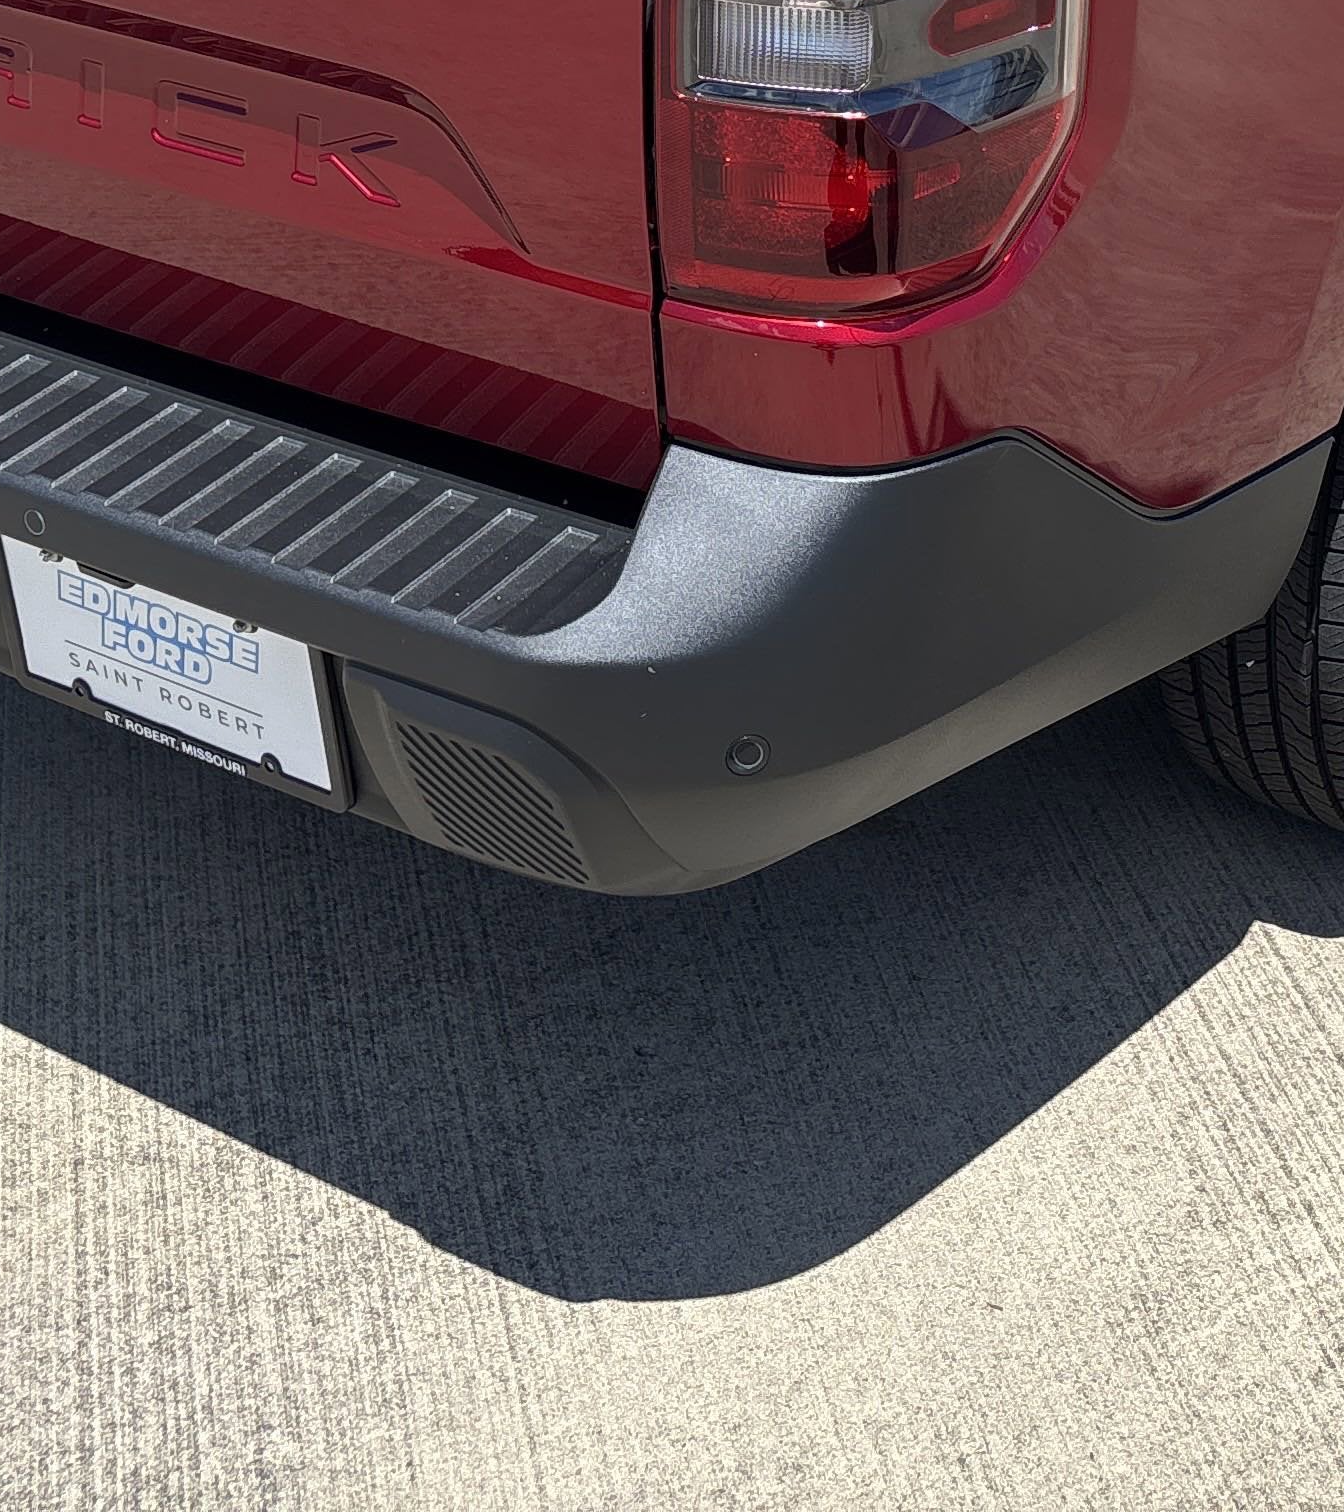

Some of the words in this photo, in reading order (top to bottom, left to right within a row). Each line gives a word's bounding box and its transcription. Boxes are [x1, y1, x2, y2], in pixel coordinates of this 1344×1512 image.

[57, 569, 111, 617] ED
[113, 589, 260, 675] MORSE
[101, 615, 213, 685] FORD
[67, 651, 145, 693] SAINT
[159, 686, 266, 740] ROBERT
[104, 710, 124, 729] ST.
[181, 740, 247, 778] MISSOURI
